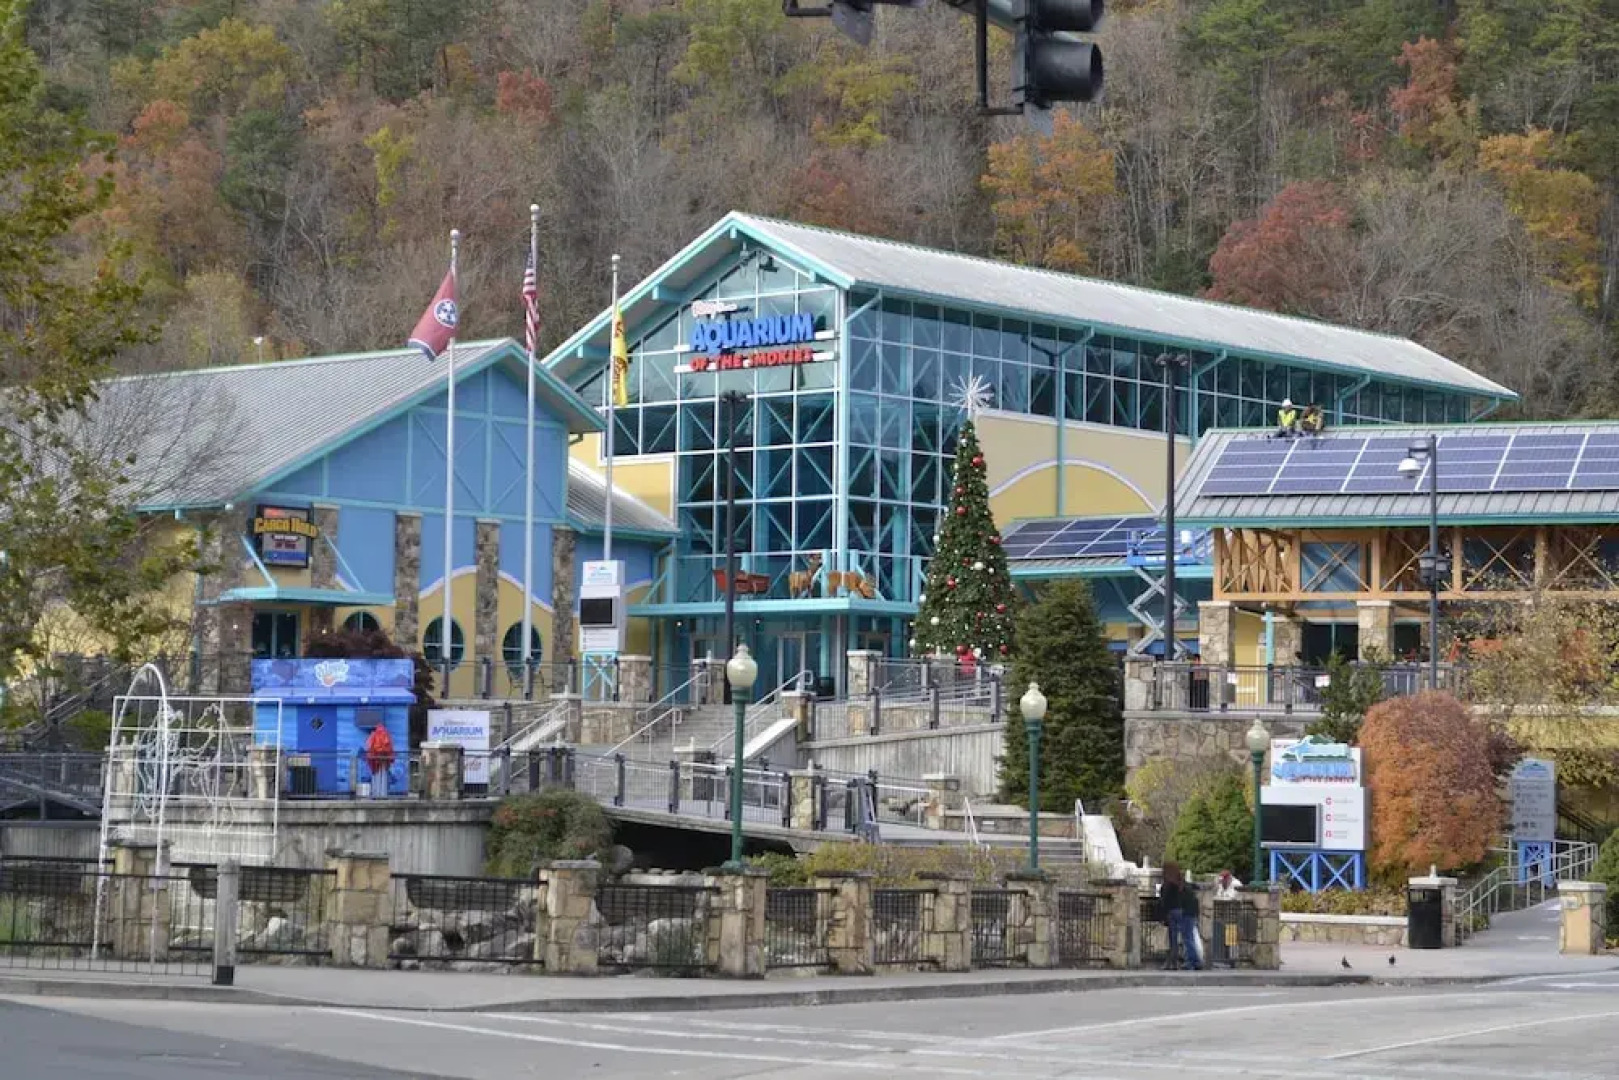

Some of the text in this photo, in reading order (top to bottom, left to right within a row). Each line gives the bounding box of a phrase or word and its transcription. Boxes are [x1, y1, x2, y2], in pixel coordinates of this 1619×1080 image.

[691, 313, 814, 356] AQUARIUM
[690, 347, 814, 371] OF THE SMOKIES
[431, 726, 483, 737] AQUARIUM
